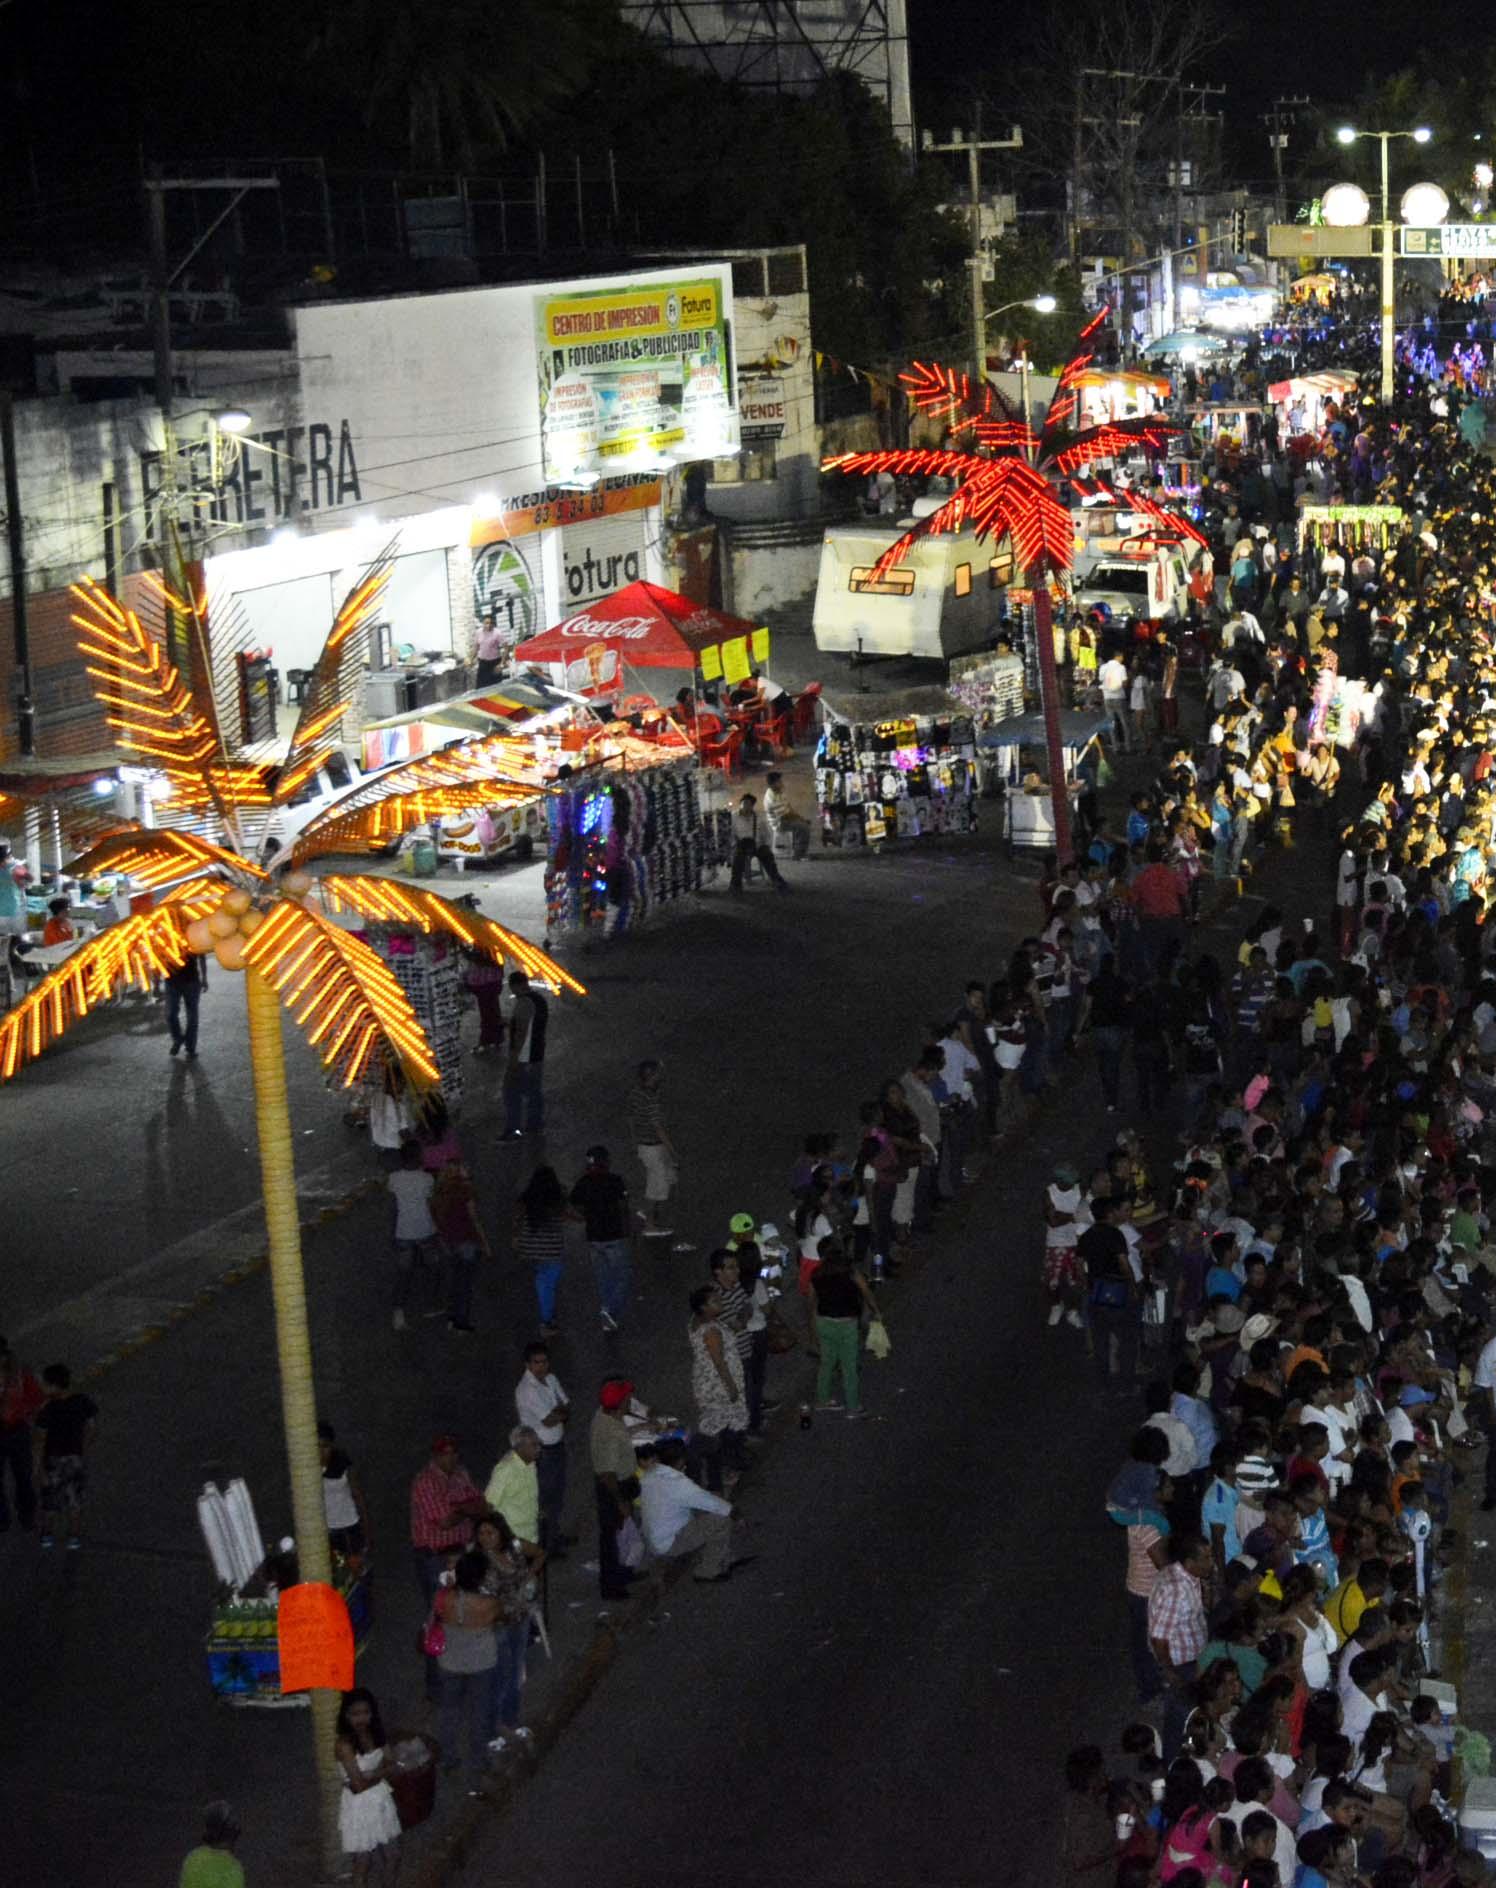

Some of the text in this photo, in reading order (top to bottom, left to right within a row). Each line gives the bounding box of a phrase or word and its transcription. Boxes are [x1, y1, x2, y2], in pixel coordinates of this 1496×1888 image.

[553, 312, 592, 337] CENTRO
[594, 311, 606, 331] DE
[643, 331, 700, 356] PUBLICIDAD
[740, 402, 784, 420] VENDE
